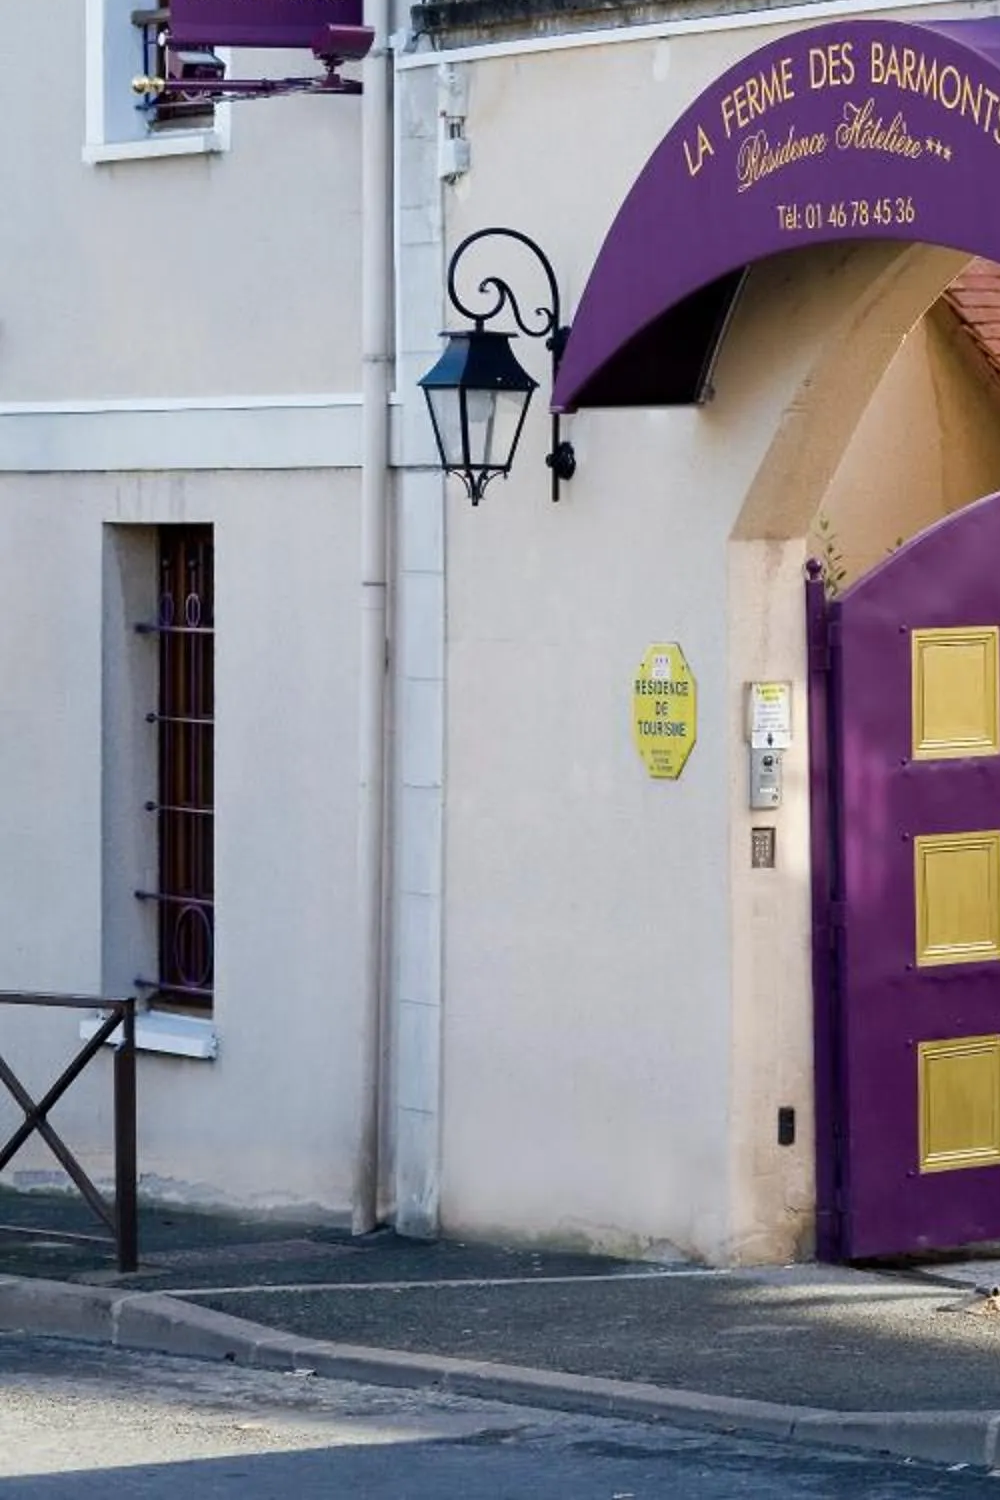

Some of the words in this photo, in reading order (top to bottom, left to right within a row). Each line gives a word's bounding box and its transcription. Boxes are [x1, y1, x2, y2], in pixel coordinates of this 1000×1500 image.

[683, 124, 715, 178] LA
[720, 57, 796, 139] FERME
[808, 41, 856, 90] DES
[805, 203, 822, 230] 01
[827, 202, 847, 228] 46
[851, 200, 870, 227] 78
[873, 198, 893, 226] 45
[895, 196, 915, 224] 36
[655, 701, 669, 716] DE
[637, 720, 686, 737] TOURISME
